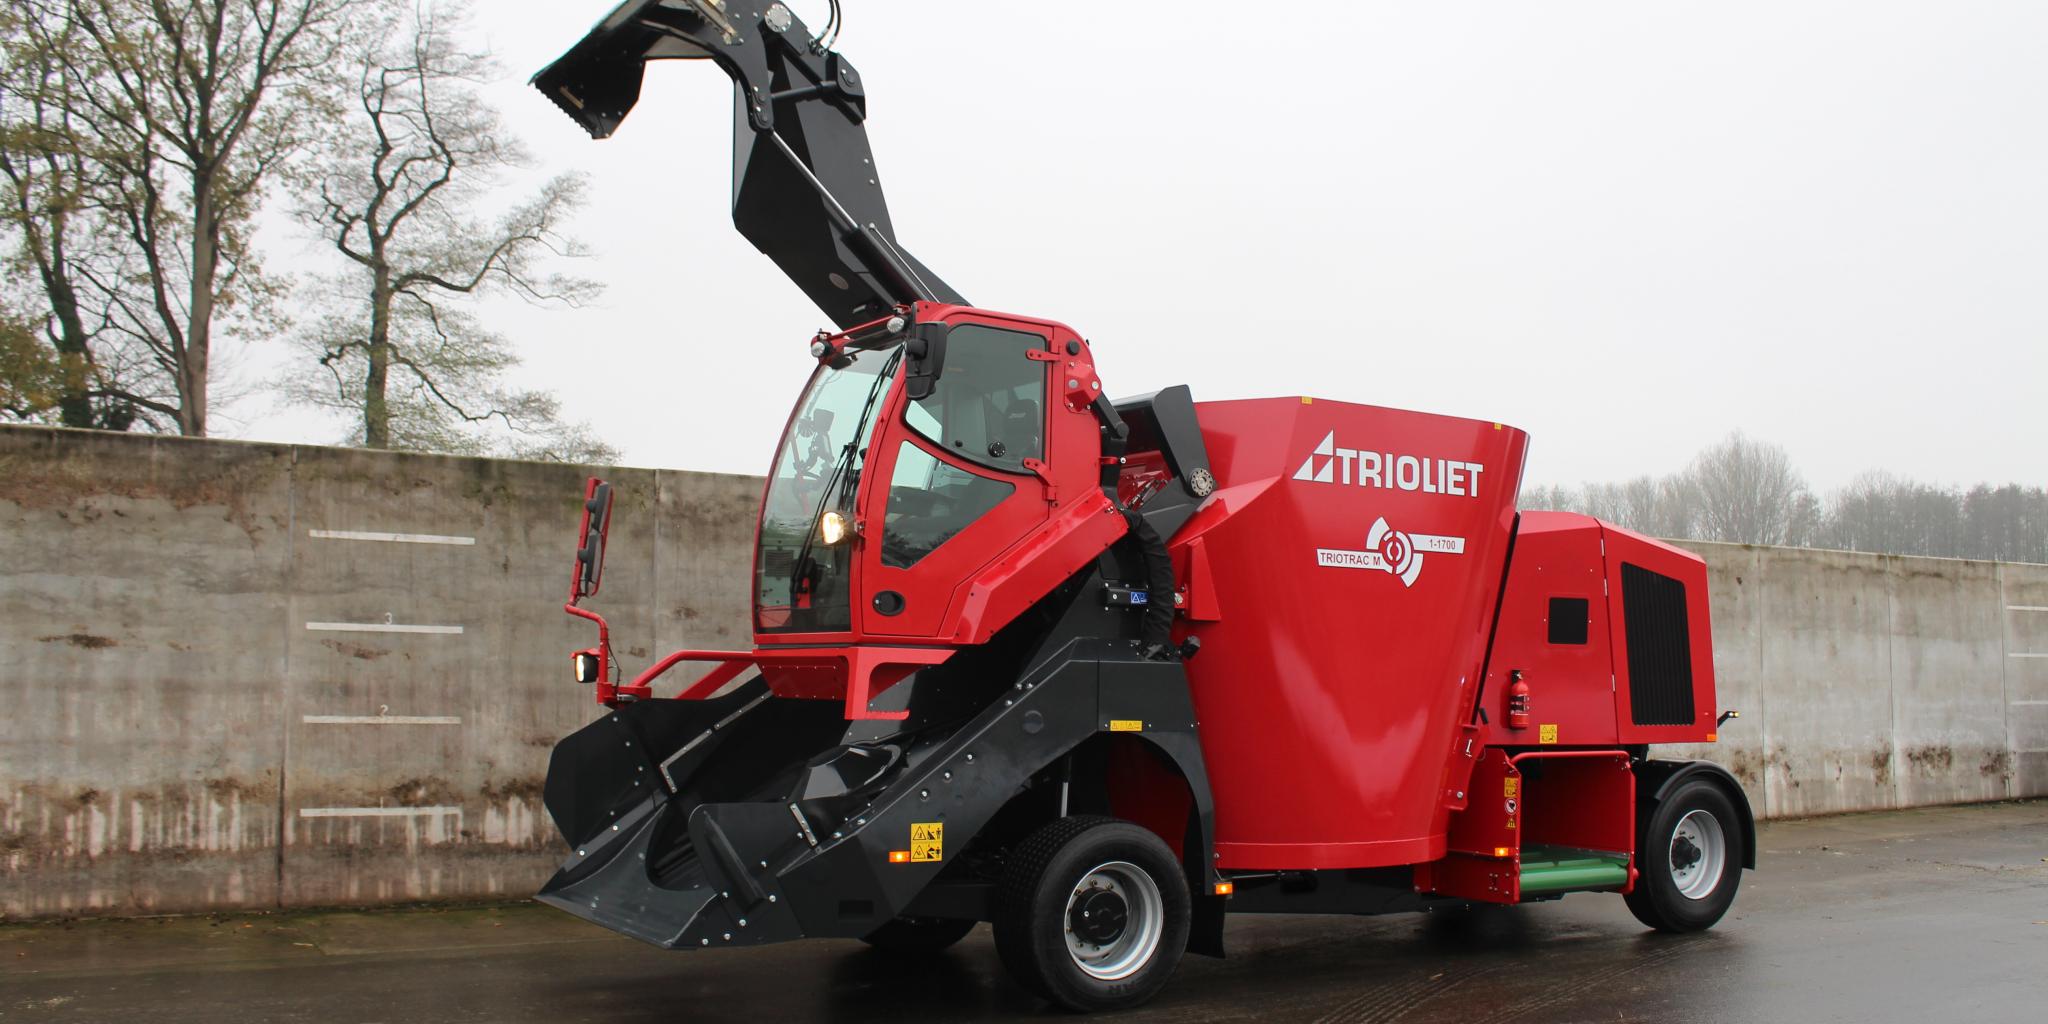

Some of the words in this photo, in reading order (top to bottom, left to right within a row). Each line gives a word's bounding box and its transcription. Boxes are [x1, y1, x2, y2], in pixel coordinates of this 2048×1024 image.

[1336, 448, 1484, 498] TRIOLIET
[1430, 539, 1456, 550] 1-1700
[1320, 552, 1370, 566] TRIOTRAC
[1373, 555, 1381, 567] M
[384, 611, 393, 625] 3
